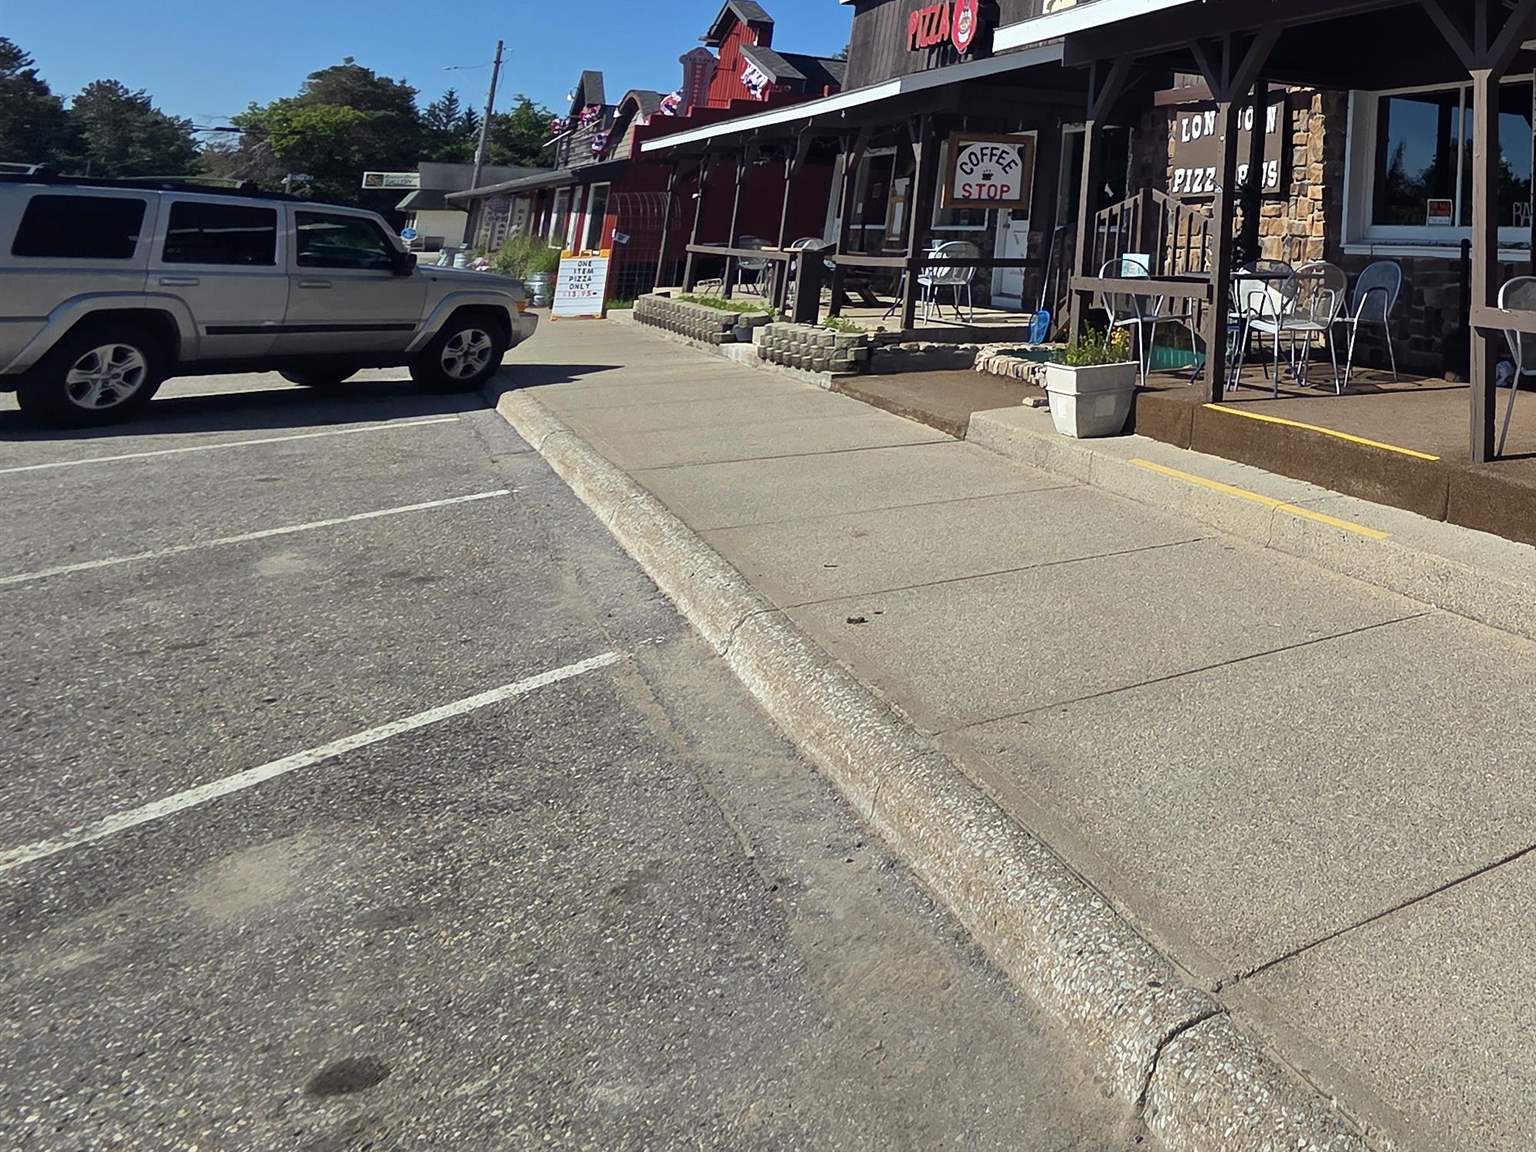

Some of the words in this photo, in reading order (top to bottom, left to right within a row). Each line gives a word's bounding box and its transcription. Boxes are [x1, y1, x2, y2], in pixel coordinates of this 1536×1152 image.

[906, 0, 950, 52] PIZZA
[960, 146, 1018, 176] COFFEE
[962, 182, 1011, 200] STOP
[1172, 166, 1217, 193] PIZZ
